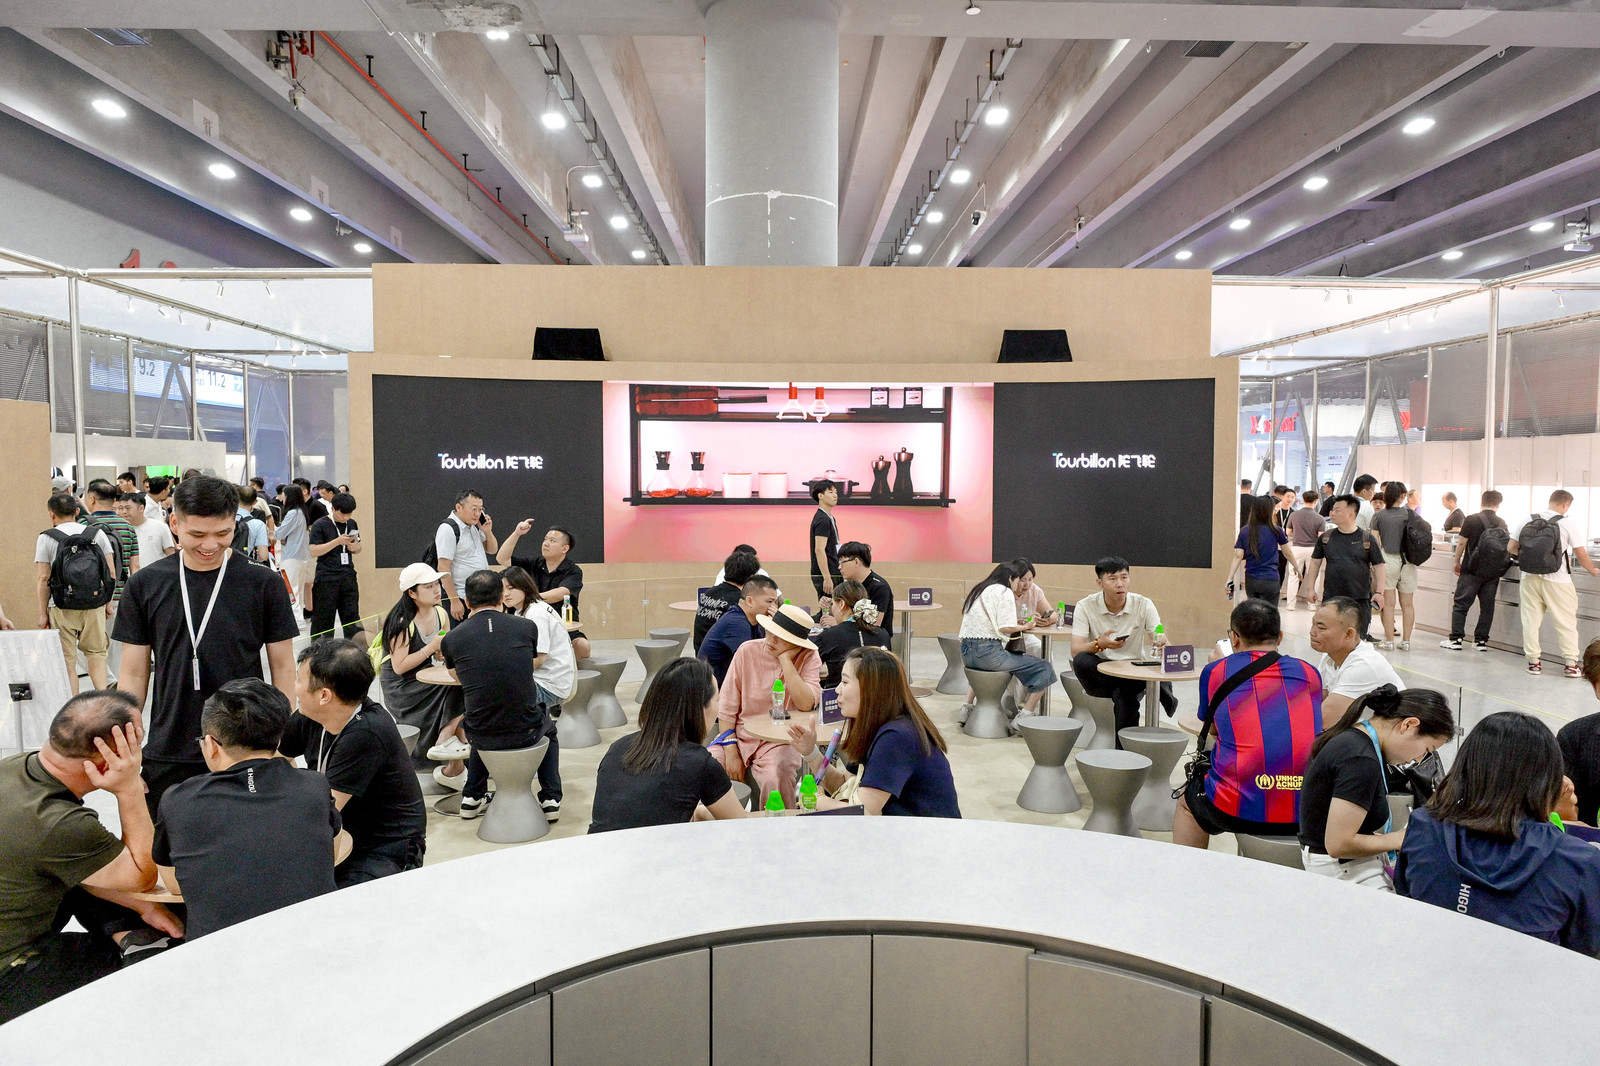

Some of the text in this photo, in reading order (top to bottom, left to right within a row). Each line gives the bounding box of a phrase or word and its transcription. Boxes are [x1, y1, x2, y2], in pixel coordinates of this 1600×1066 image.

[139, 358, 155, 376] 9.2
[208, 368, 226, 388] 11.2
[438, 453, 504, 469] Tourbillon
[1052, 452, 1116, 468] Tourbillon
